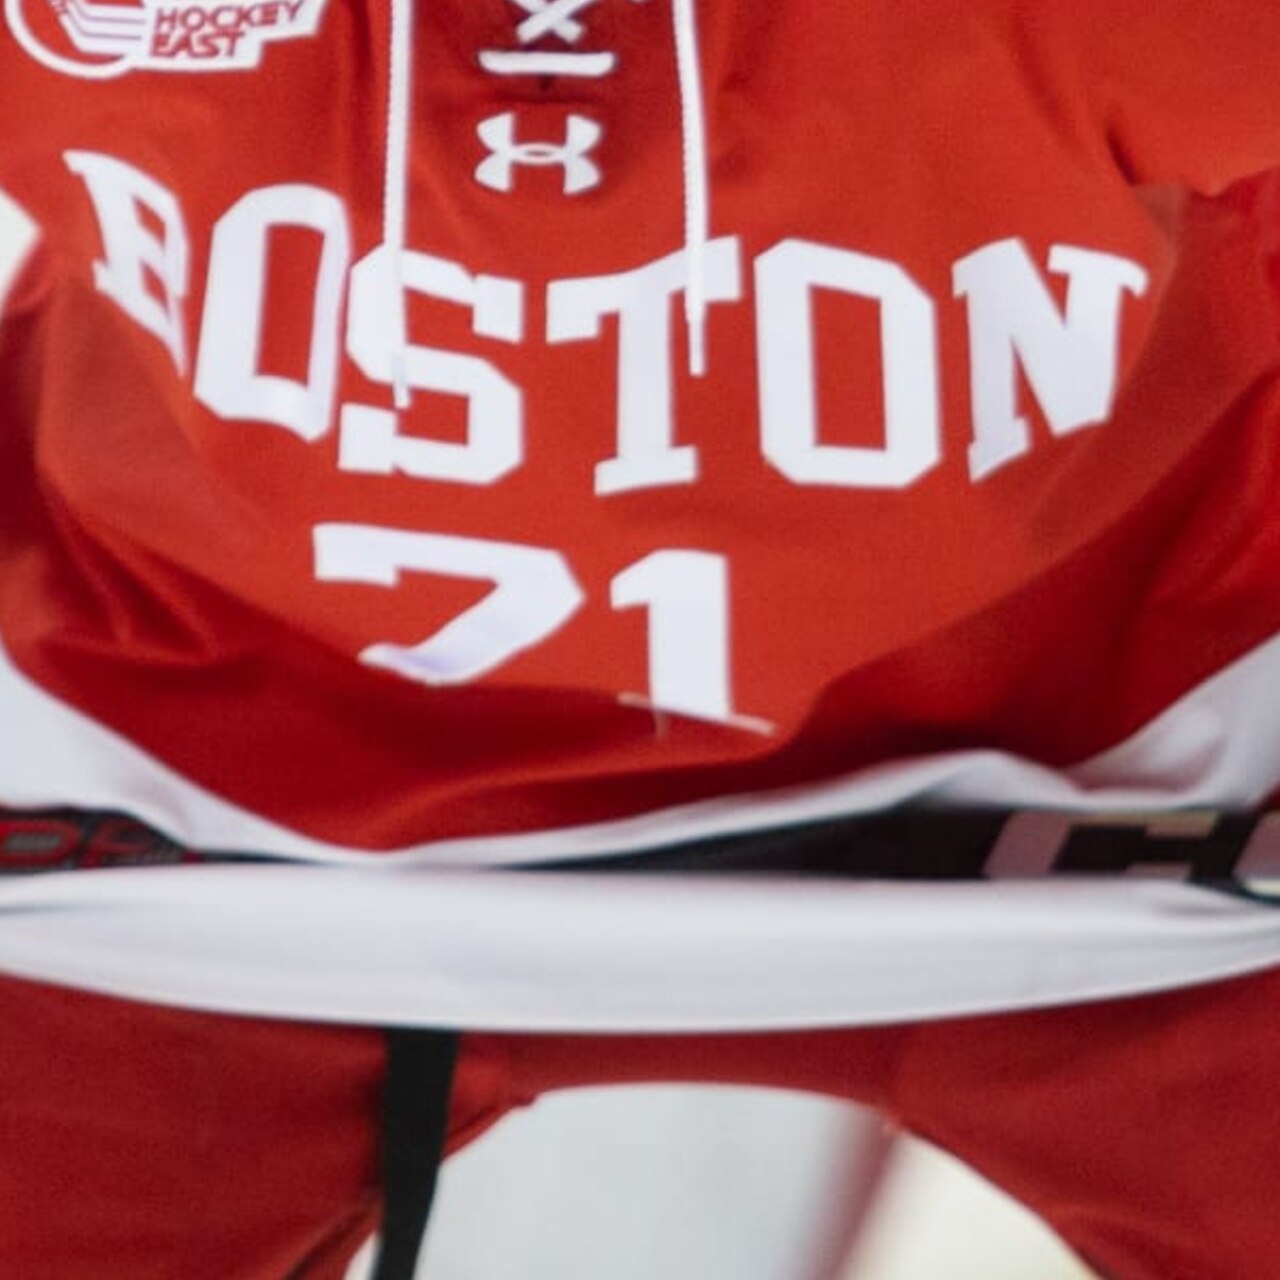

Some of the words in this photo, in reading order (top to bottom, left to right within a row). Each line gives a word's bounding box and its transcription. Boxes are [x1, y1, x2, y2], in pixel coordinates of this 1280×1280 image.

[150, 30, 246, 58] EAST
[63, 150, 1147, 495] BOSTON
[314, 522, 774, 735] 71
